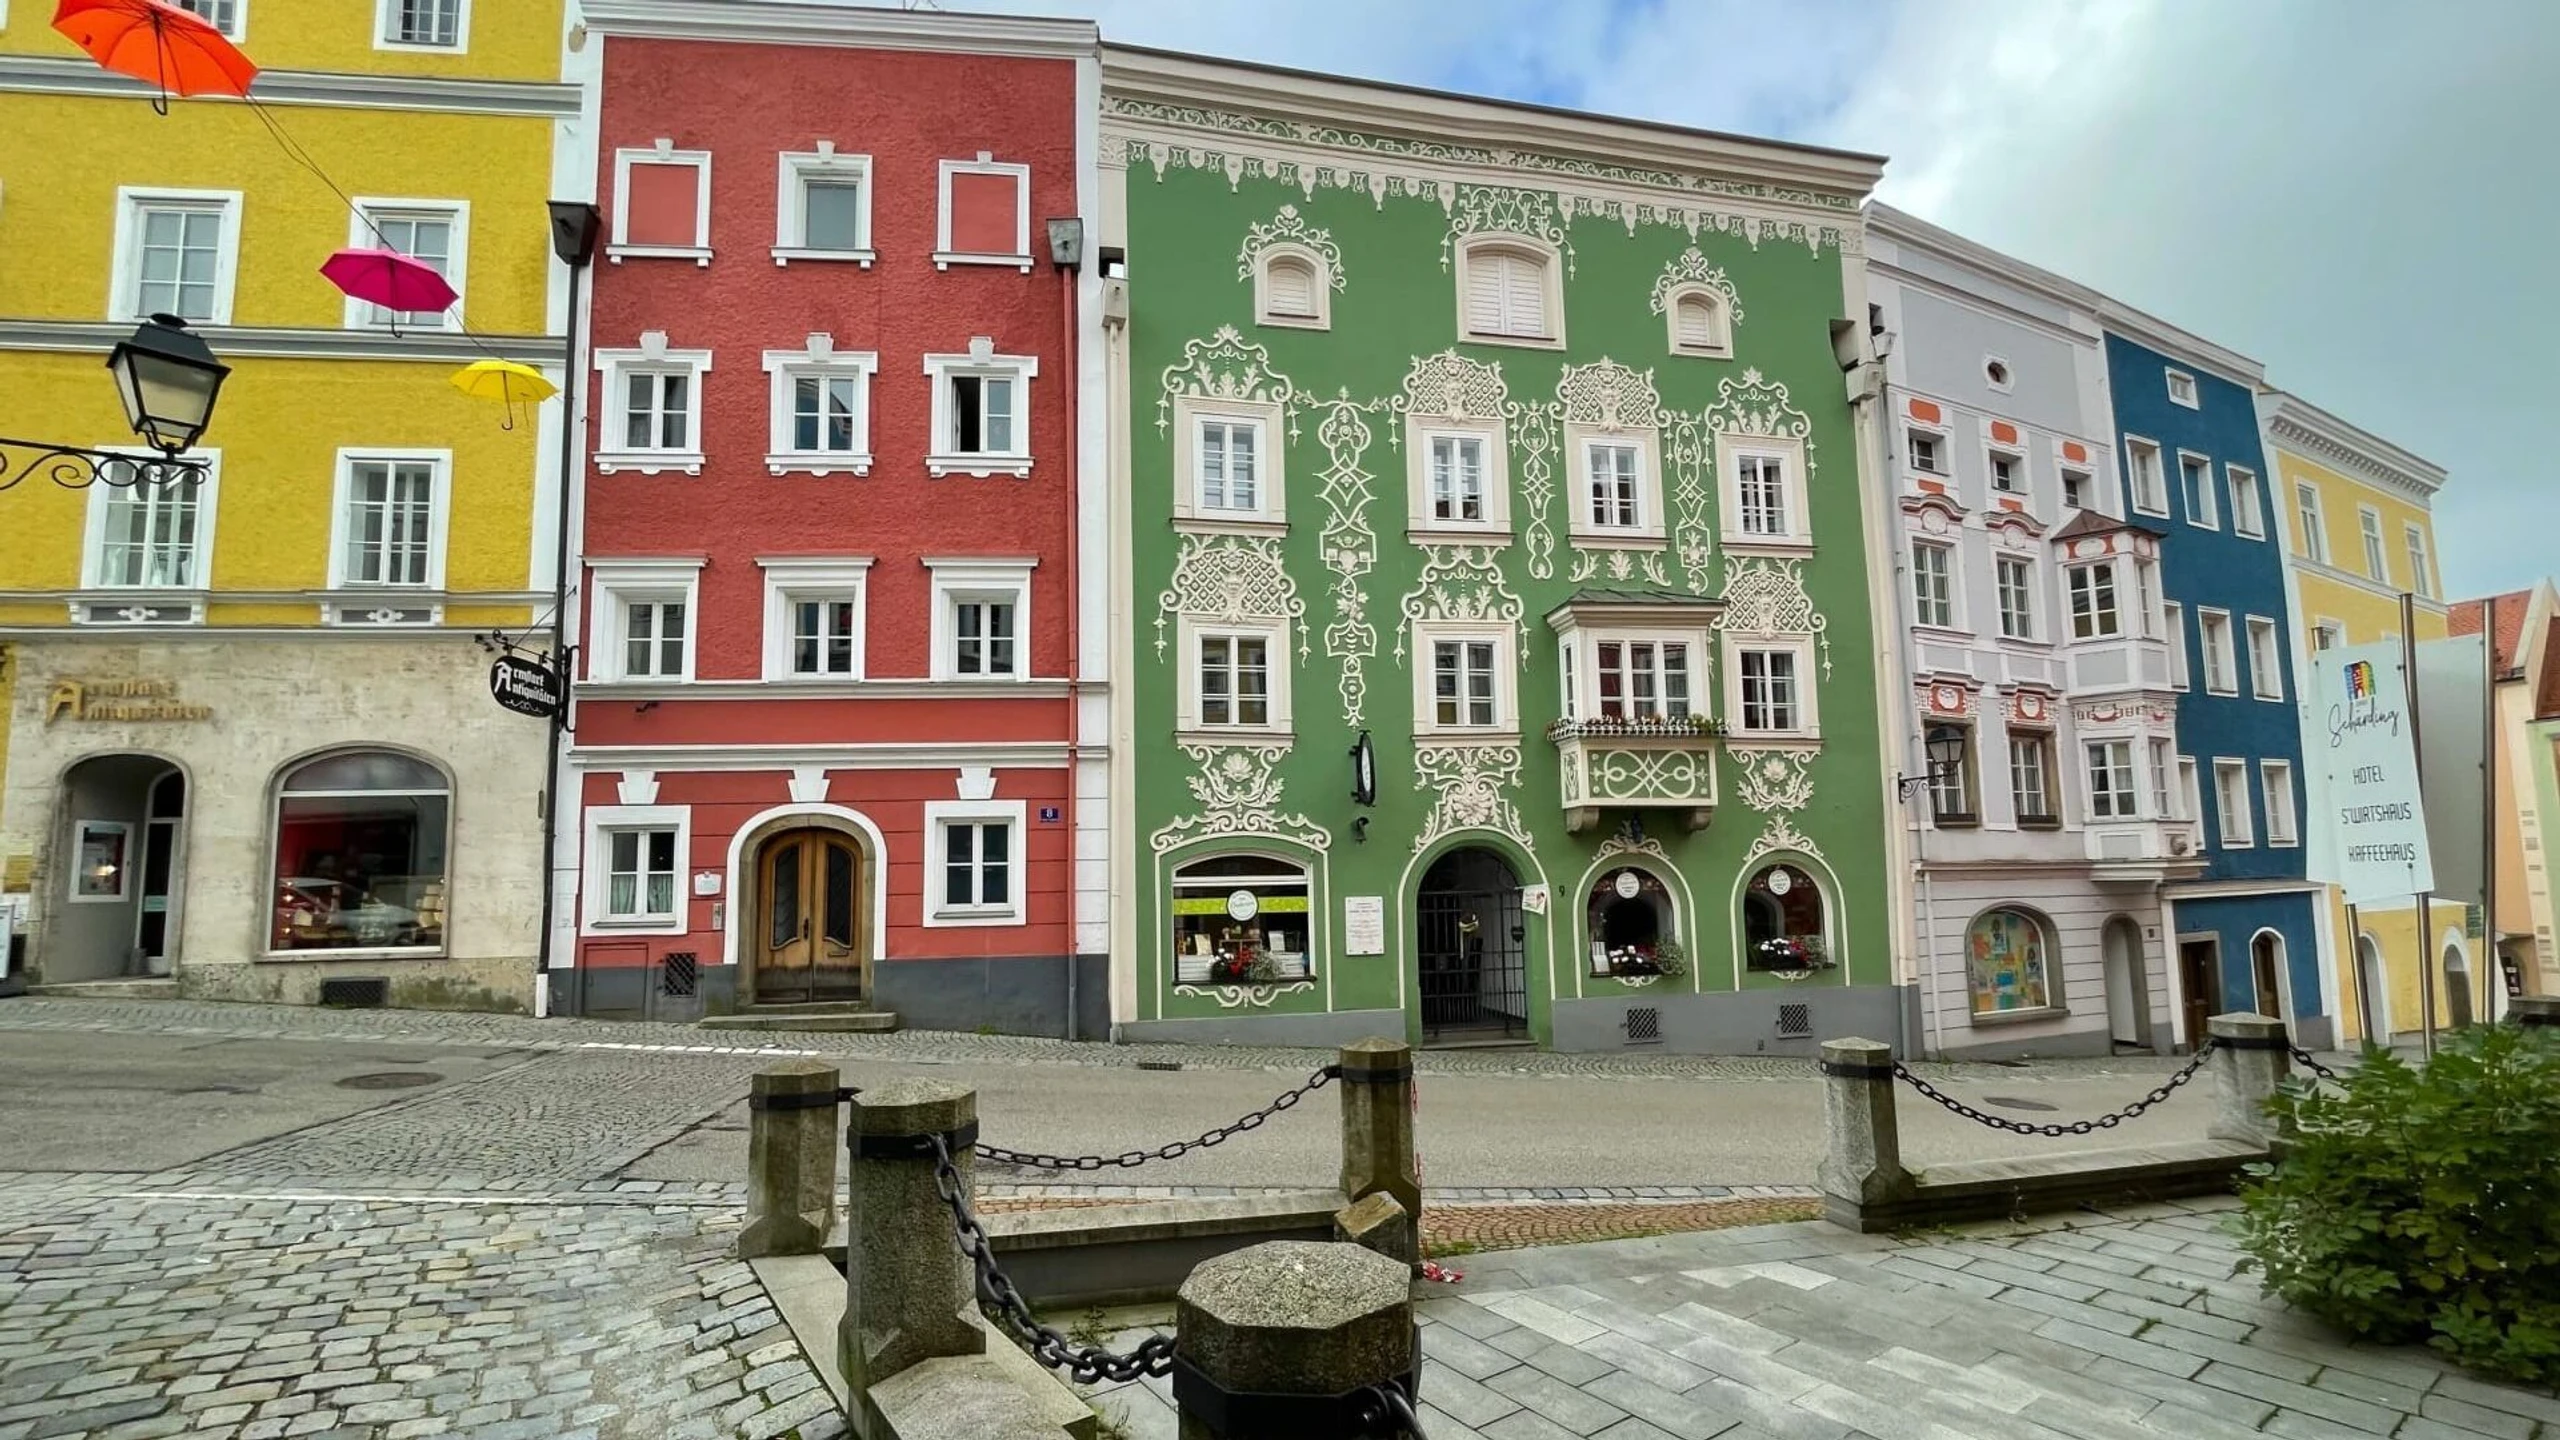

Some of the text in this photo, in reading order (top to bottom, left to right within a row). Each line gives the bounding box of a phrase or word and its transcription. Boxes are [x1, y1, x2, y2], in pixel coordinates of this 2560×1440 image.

[2352, 765, 2385, 784] HOTEL
[2347, 842, 2416, 862] KAFFEEHAUS
[1559, 885, 1566, 897] 9
